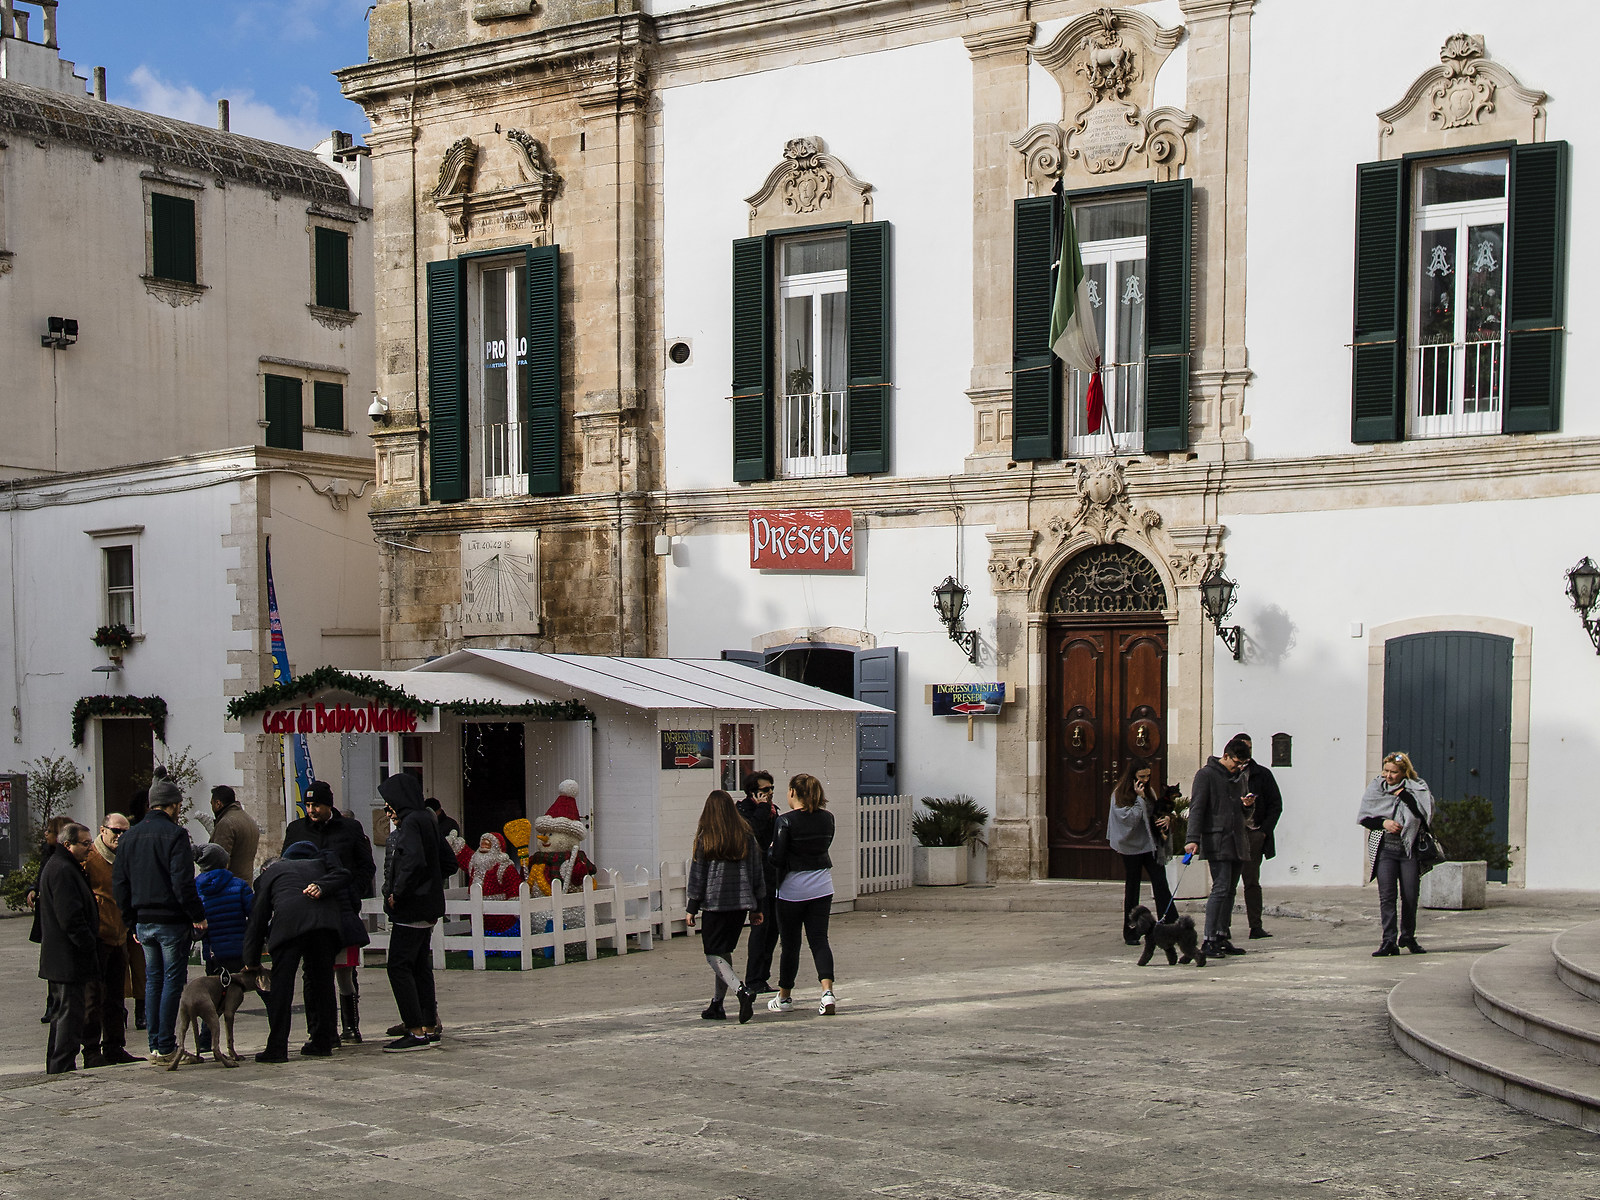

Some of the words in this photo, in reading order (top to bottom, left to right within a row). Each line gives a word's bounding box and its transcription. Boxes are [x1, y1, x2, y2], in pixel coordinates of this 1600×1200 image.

[486, 340, 505, 360] PRO
[1054, 594, 1167, 613] ARTIGIANA
[937, 684, 973, 693] INGRESSO
[975, 684, 999, 692] VISITA
[953, 694, 982, 702] PRESEPI
[297, 703, 314, 734] di
[315, 703, 366, 733] Babbo
[664, 732, 691, 743] INGRESSO
[693, 732, 710, 742] VISITA
